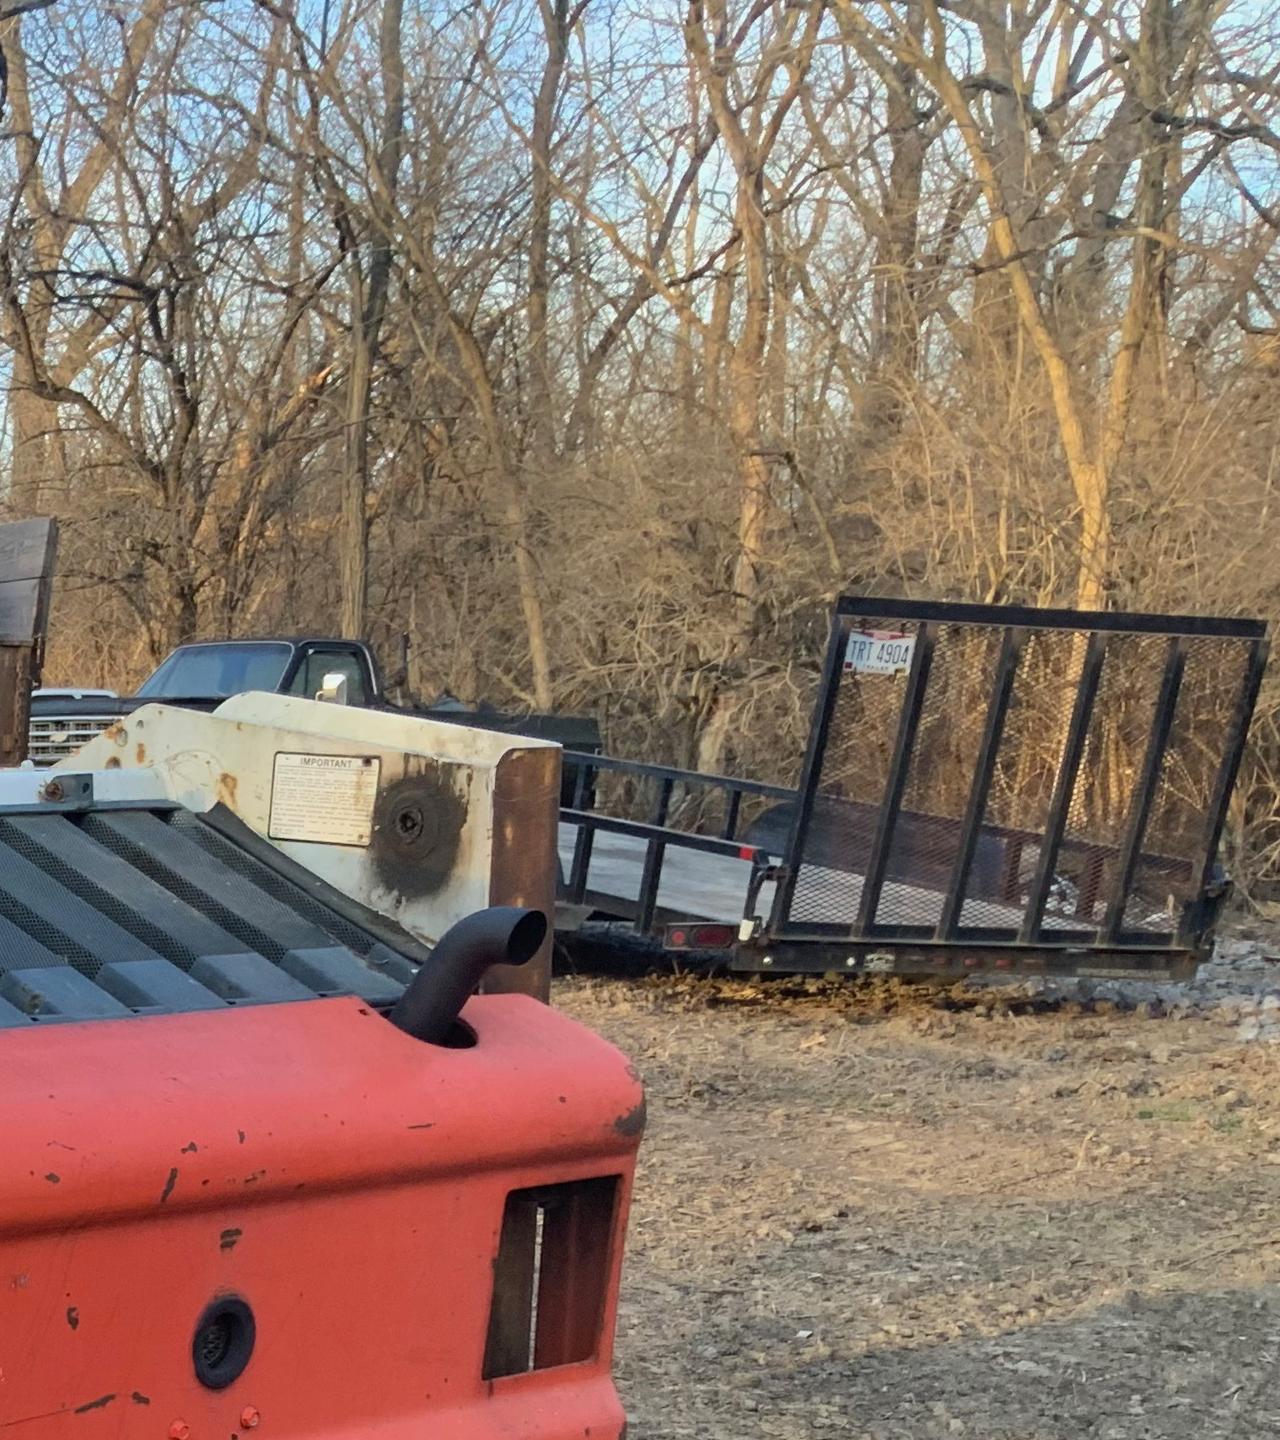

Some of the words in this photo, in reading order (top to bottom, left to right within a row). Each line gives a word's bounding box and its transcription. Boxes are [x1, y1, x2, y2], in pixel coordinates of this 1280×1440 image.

[851, 640, 874, 662] TRT
[877, 643, 909, 665] 4904
[300, 757, 352, 769] IMPORTANT
